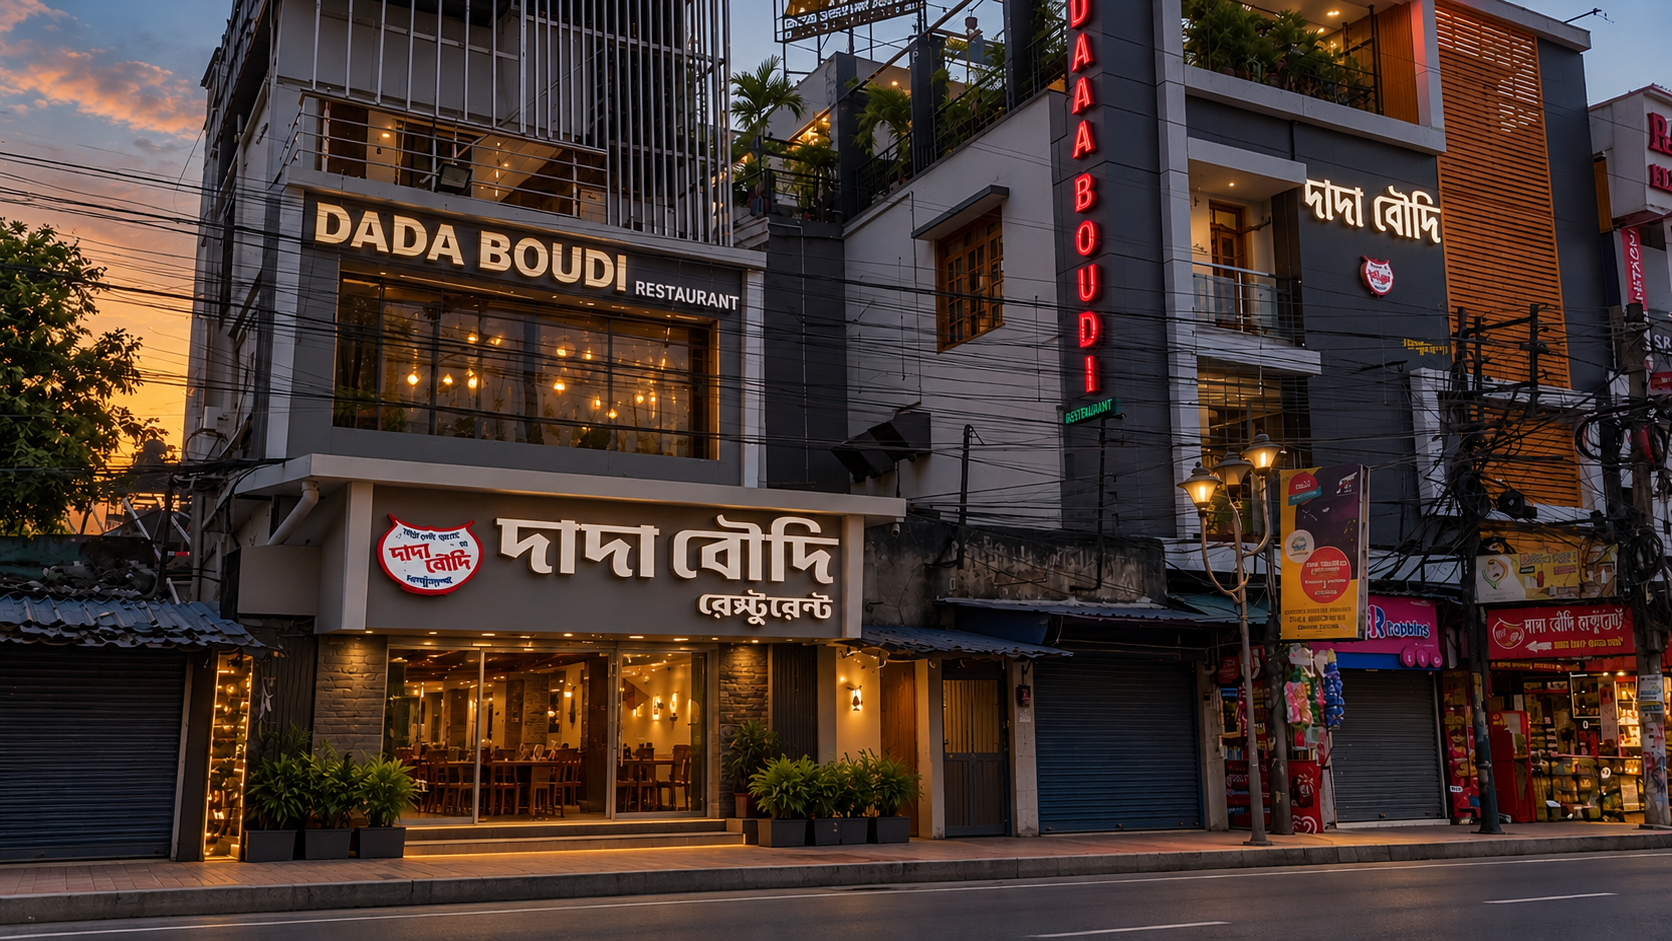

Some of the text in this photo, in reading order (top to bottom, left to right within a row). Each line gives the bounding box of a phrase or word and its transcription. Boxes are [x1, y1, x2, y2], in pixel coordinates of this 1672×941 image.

[1305, 179, 1441, 244] দাদা বৌদি
[315, 202, 739, 311] DADA BOUDI RESTAURANT
[389, 543, 431, 562] দাদা
[425, 550, 471, 573] বৌদি
[494, 513, 839, 585] দাদা বৌদি
